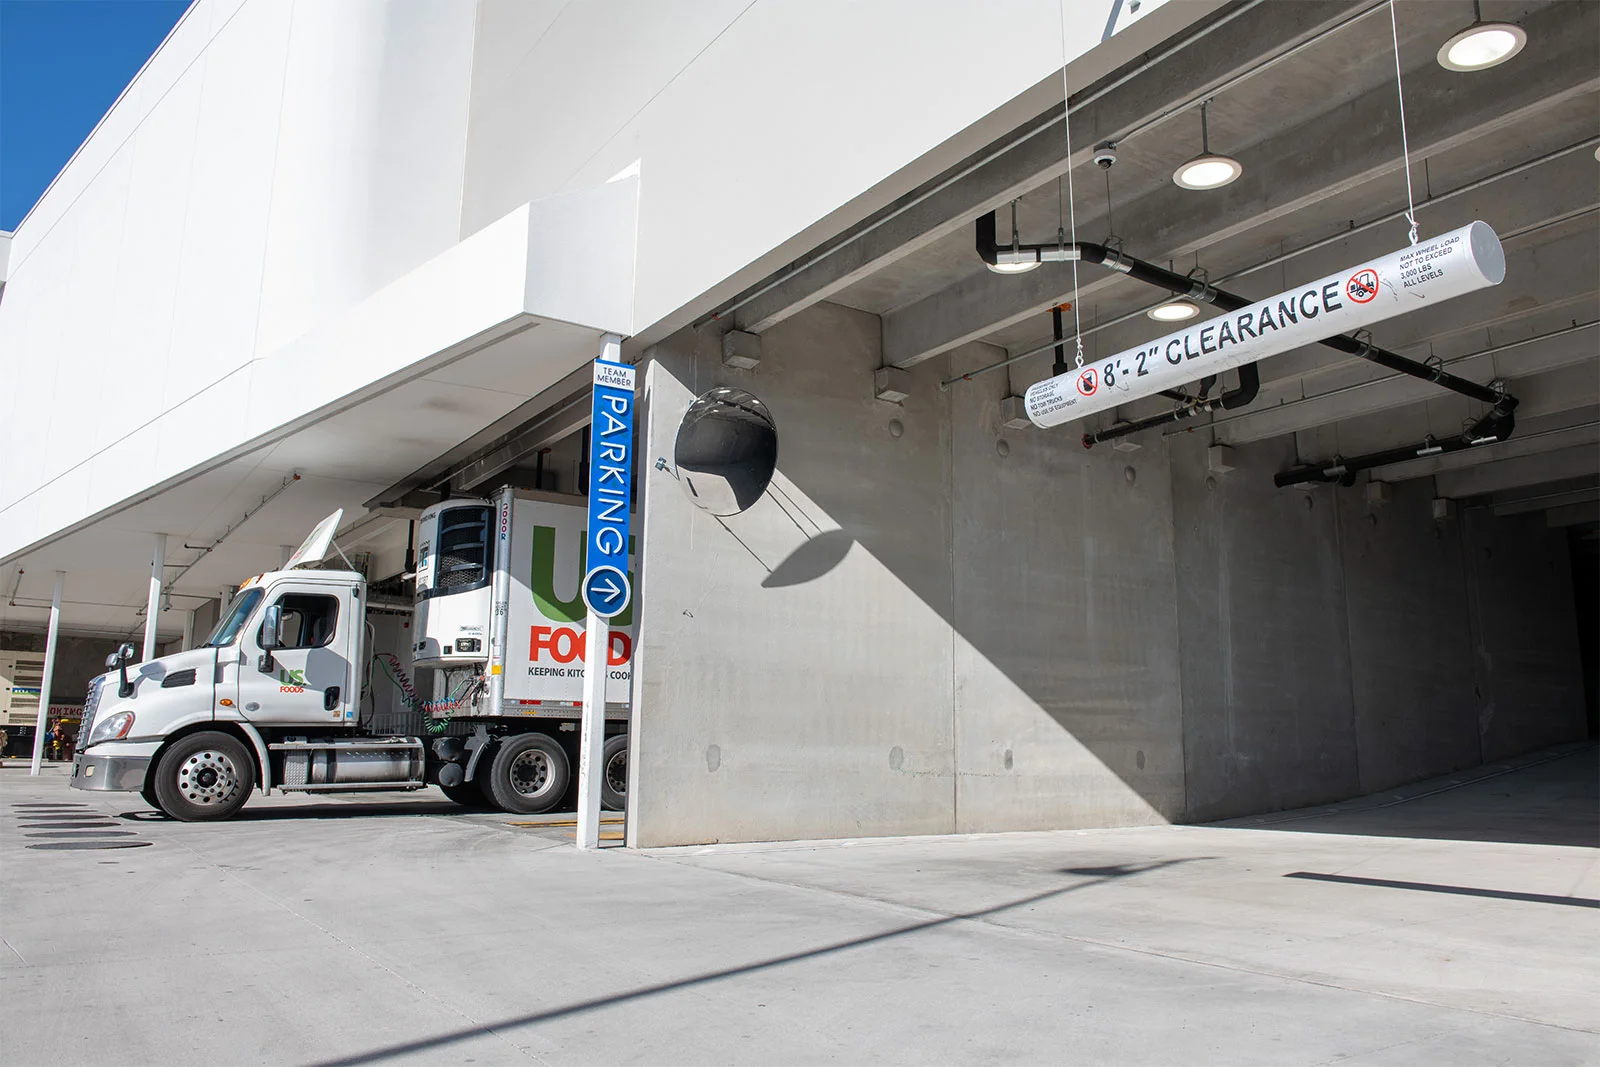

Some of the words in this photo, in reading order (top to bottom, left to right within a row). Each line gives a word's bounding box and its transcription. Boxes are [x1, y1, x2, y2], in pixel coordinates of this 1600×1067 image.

[1400, 252, 1414, 262] MAX
[1415, 244, 1439, 256] WHEEL
[1440, 236, 1460, 248] LOAD
[1400, 260, 1413, 270] NOT
[1414, 256, 1424, 265] TO
[1425, 246, 1453, 261] EXCEED
[1418, 263, 1432, 274] LBS
[1403, 278, 1417, 288] ALL
[1417, 269, 1444, 284] LEVELS
[1165, 280, 1343, 365] CLEARANCE
[603, 367, 627, 378] TEAM
[597, 374, 631, 387] MEMBER
[1047, 396, 1063, 405] TRUCKS
[595, 395, 628, 555] PARKING
[528, 666, 565, 677] KEEPING
[48, 706, 82, 717] OKING
